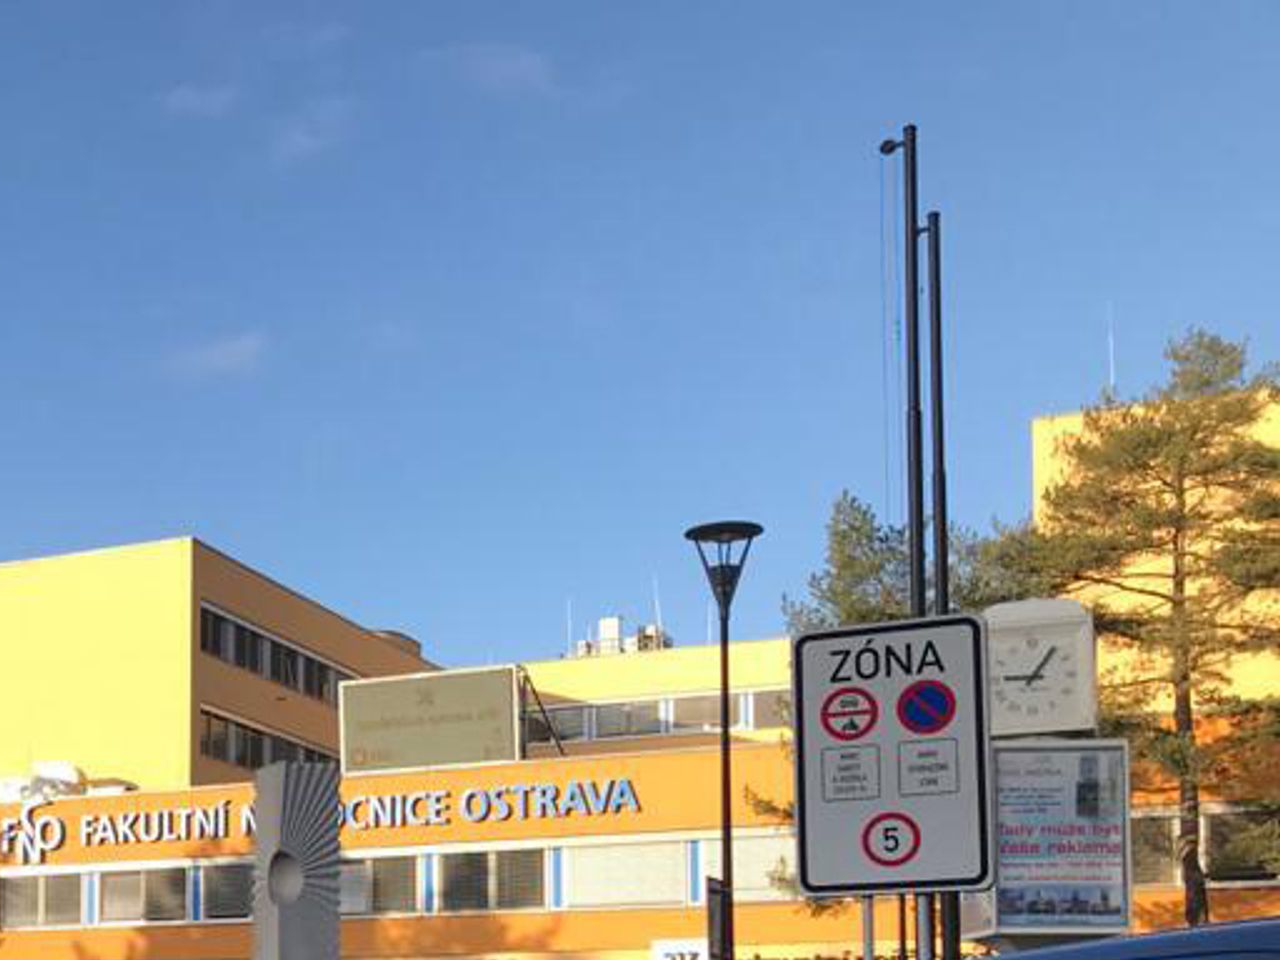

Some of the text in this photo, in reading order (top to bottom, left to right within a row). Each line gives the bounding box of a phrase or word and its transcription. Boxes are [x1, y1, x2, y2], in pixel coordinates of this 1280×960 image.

[828, 638, 945, 683] ZÓNA
[80, 799, 232, 847] FAKULTNÍ
[460, 778, 642, 824] OSTRAVA
[882, 826, 900, 853] 5
